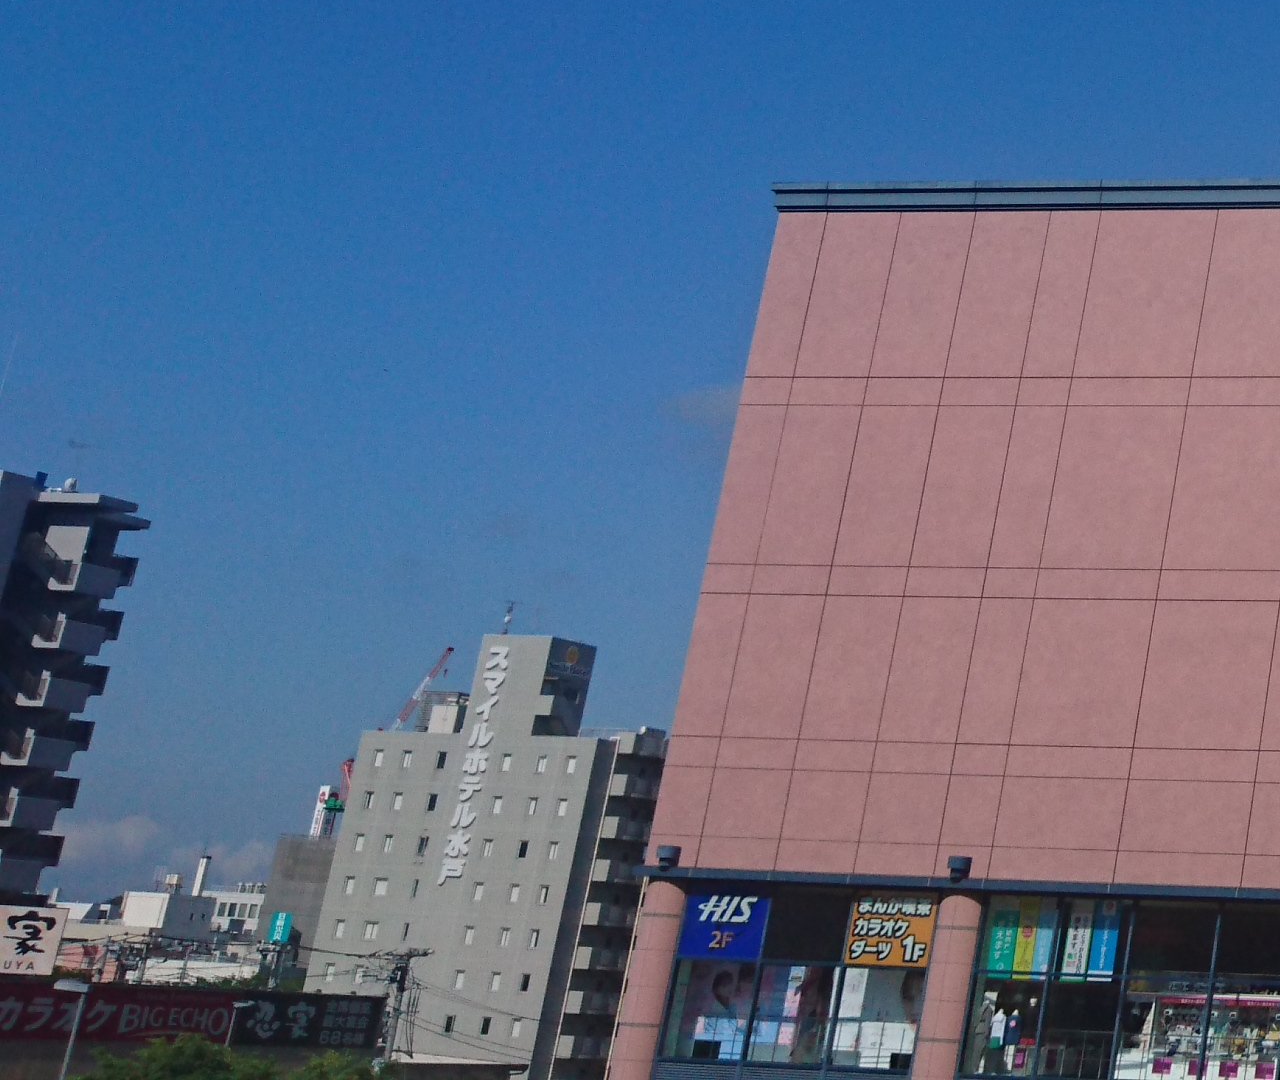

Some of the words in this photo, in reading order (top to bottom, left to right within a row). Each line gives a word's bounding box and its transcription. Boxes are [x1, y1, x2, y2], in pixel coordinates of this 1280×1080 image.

[438, 646, 509, 887] スマイルホテル水戸
[708, 930, 735, 949] 2F
[852, 918, 910, 937] カラオケ
[850, 940, 893, 959] ダーツ
[902, 935, 927, 962] 1F
[0, 996, 117, 1032] カラオケ
[167, 1007, 230, 1036] ECHO
